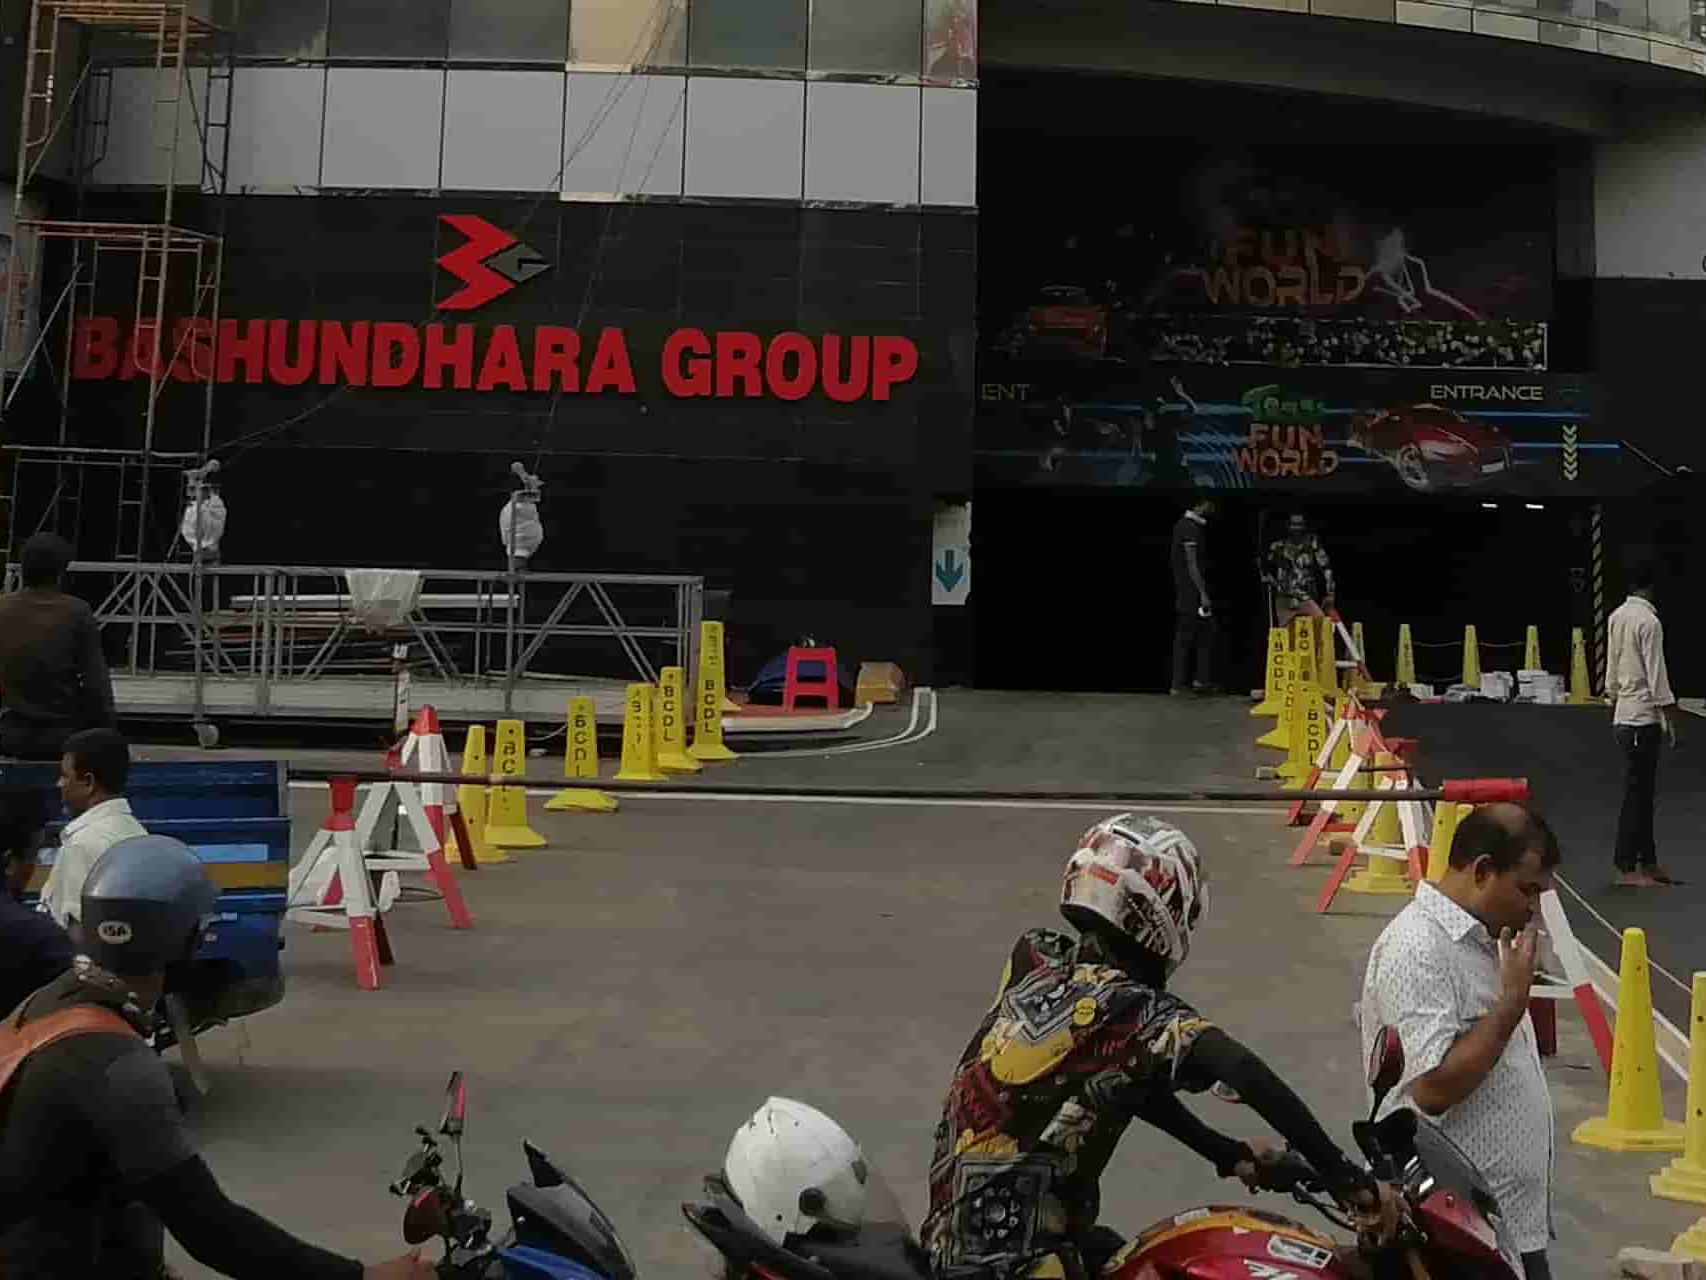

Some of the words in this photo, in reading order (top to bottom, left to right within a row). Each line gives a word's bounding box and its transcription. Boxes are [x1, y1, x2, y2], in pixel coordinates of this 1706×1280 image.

[1204, 262, 1367, 306] WORLD
[73, 317, 637, 394] BASHUNDHARA
[661, 328, 920, 401] GROUP
[1430, 384, 1544, 401] ENTRANCE
[1248, 423, 1324, 450] FUN
[1231, 446, 1340, 481] WORLD
